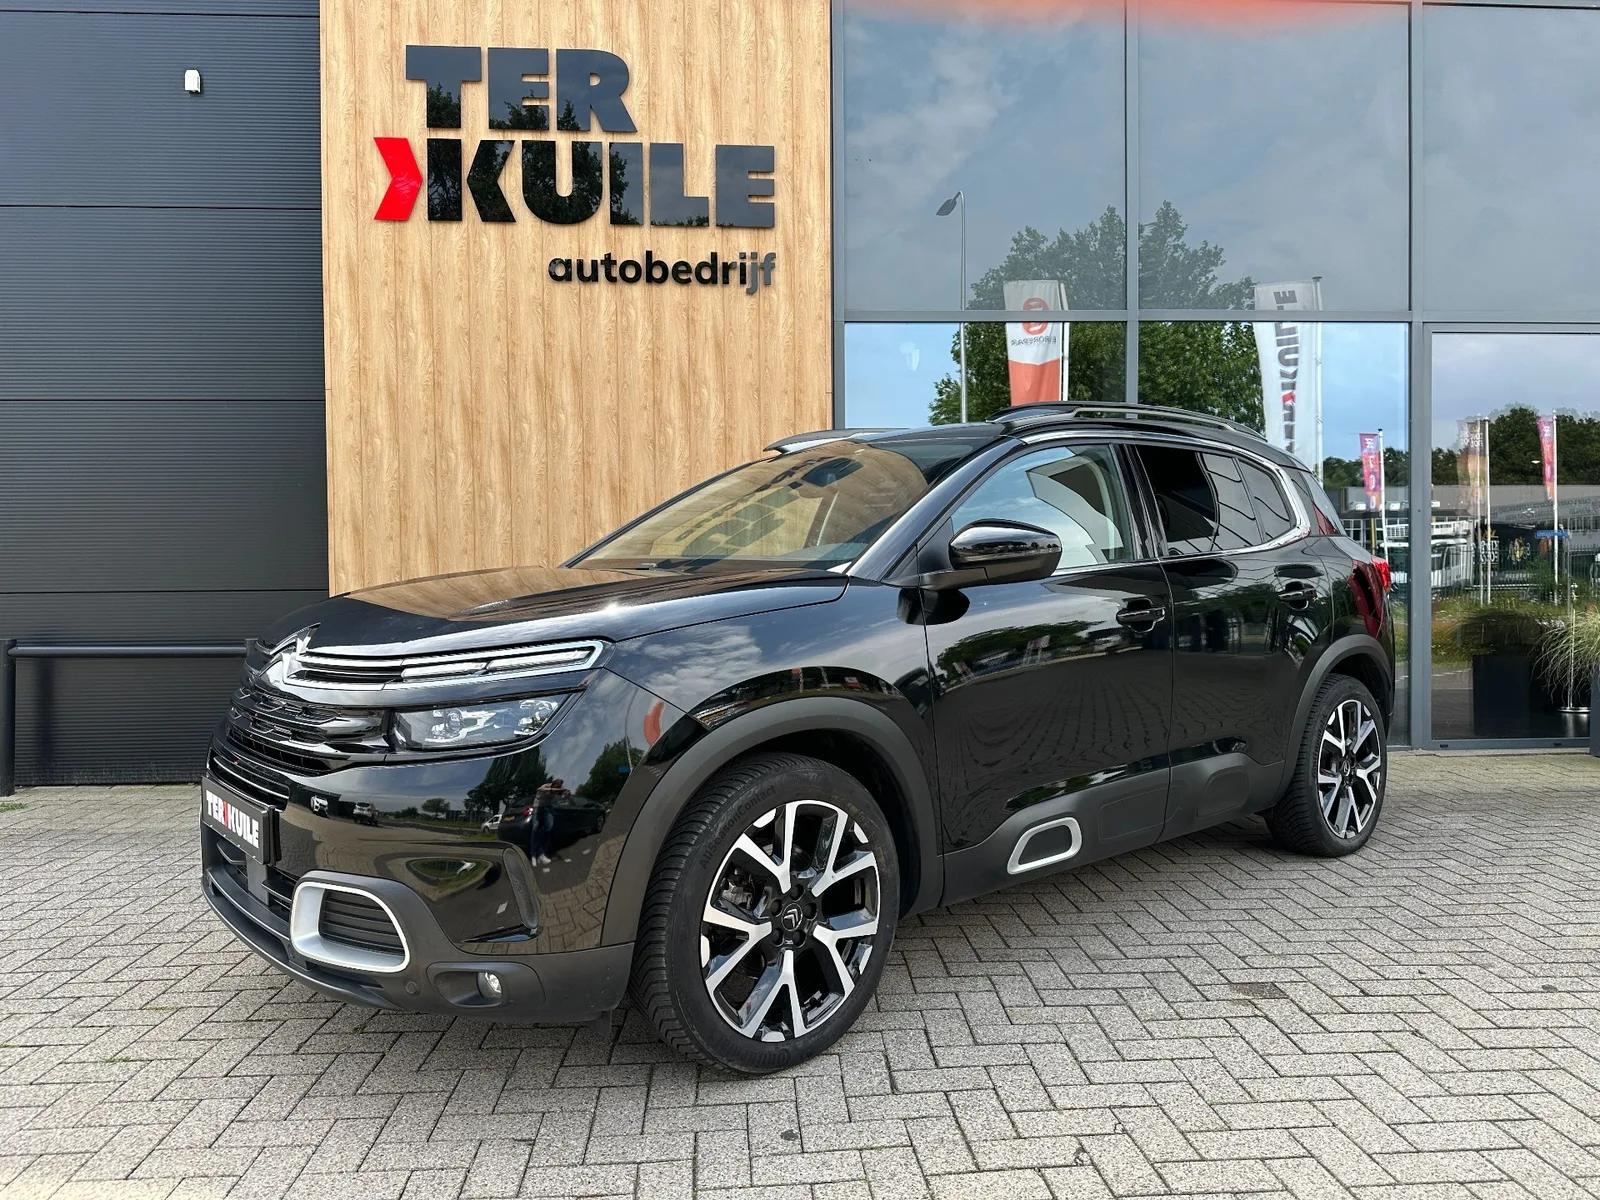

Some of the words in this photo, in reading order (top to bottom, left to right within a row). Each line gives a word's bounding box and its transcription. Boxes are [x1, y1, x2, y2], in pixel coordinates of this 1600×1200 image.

[405, 45, 638, 133] TER
[427, 138, 775, 228] KUILE
[548, 250, 776, 295] autobedrijf
[699, 785, 776, 869] AllSeasonContact
